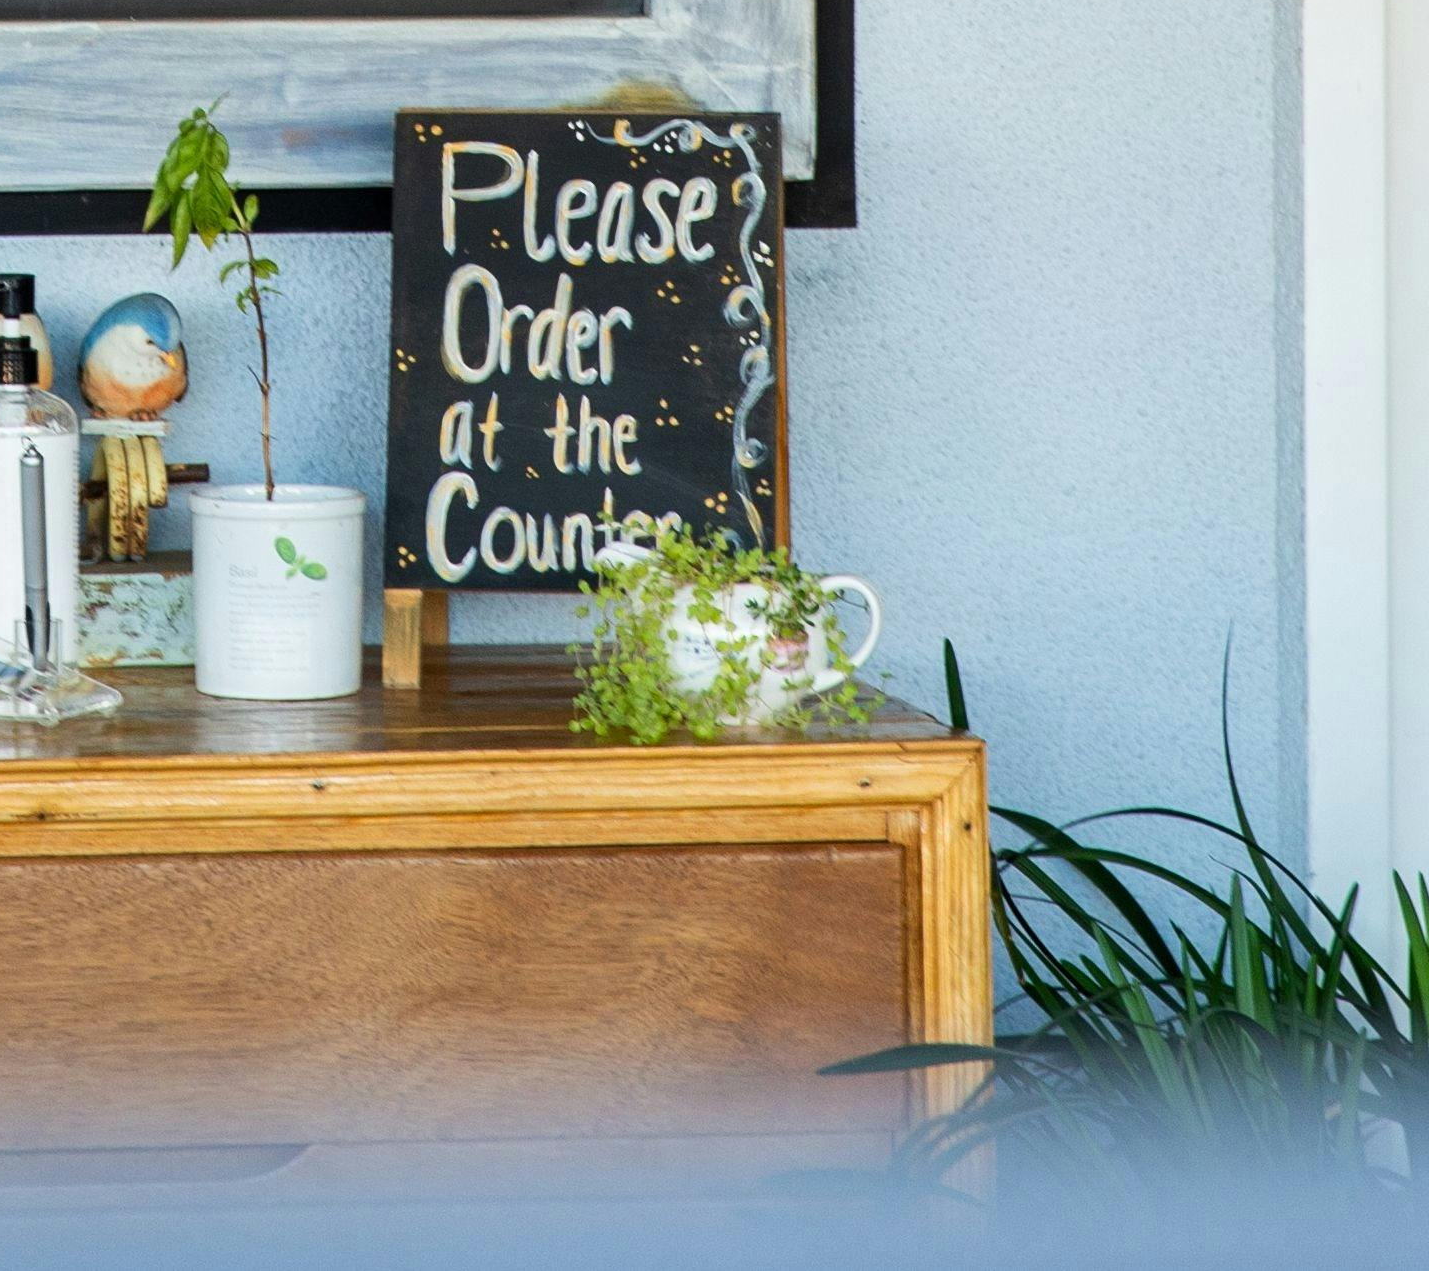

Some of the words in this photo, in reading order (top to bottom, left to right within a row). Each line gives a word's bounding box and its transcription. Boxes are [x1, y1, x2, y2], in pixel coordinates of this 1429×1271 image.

[441, 140, 718, 266] Please
[441, 262, 634, 386] Order
[439, 390, 502, 474] at
[542, 391, 642, 477] the
